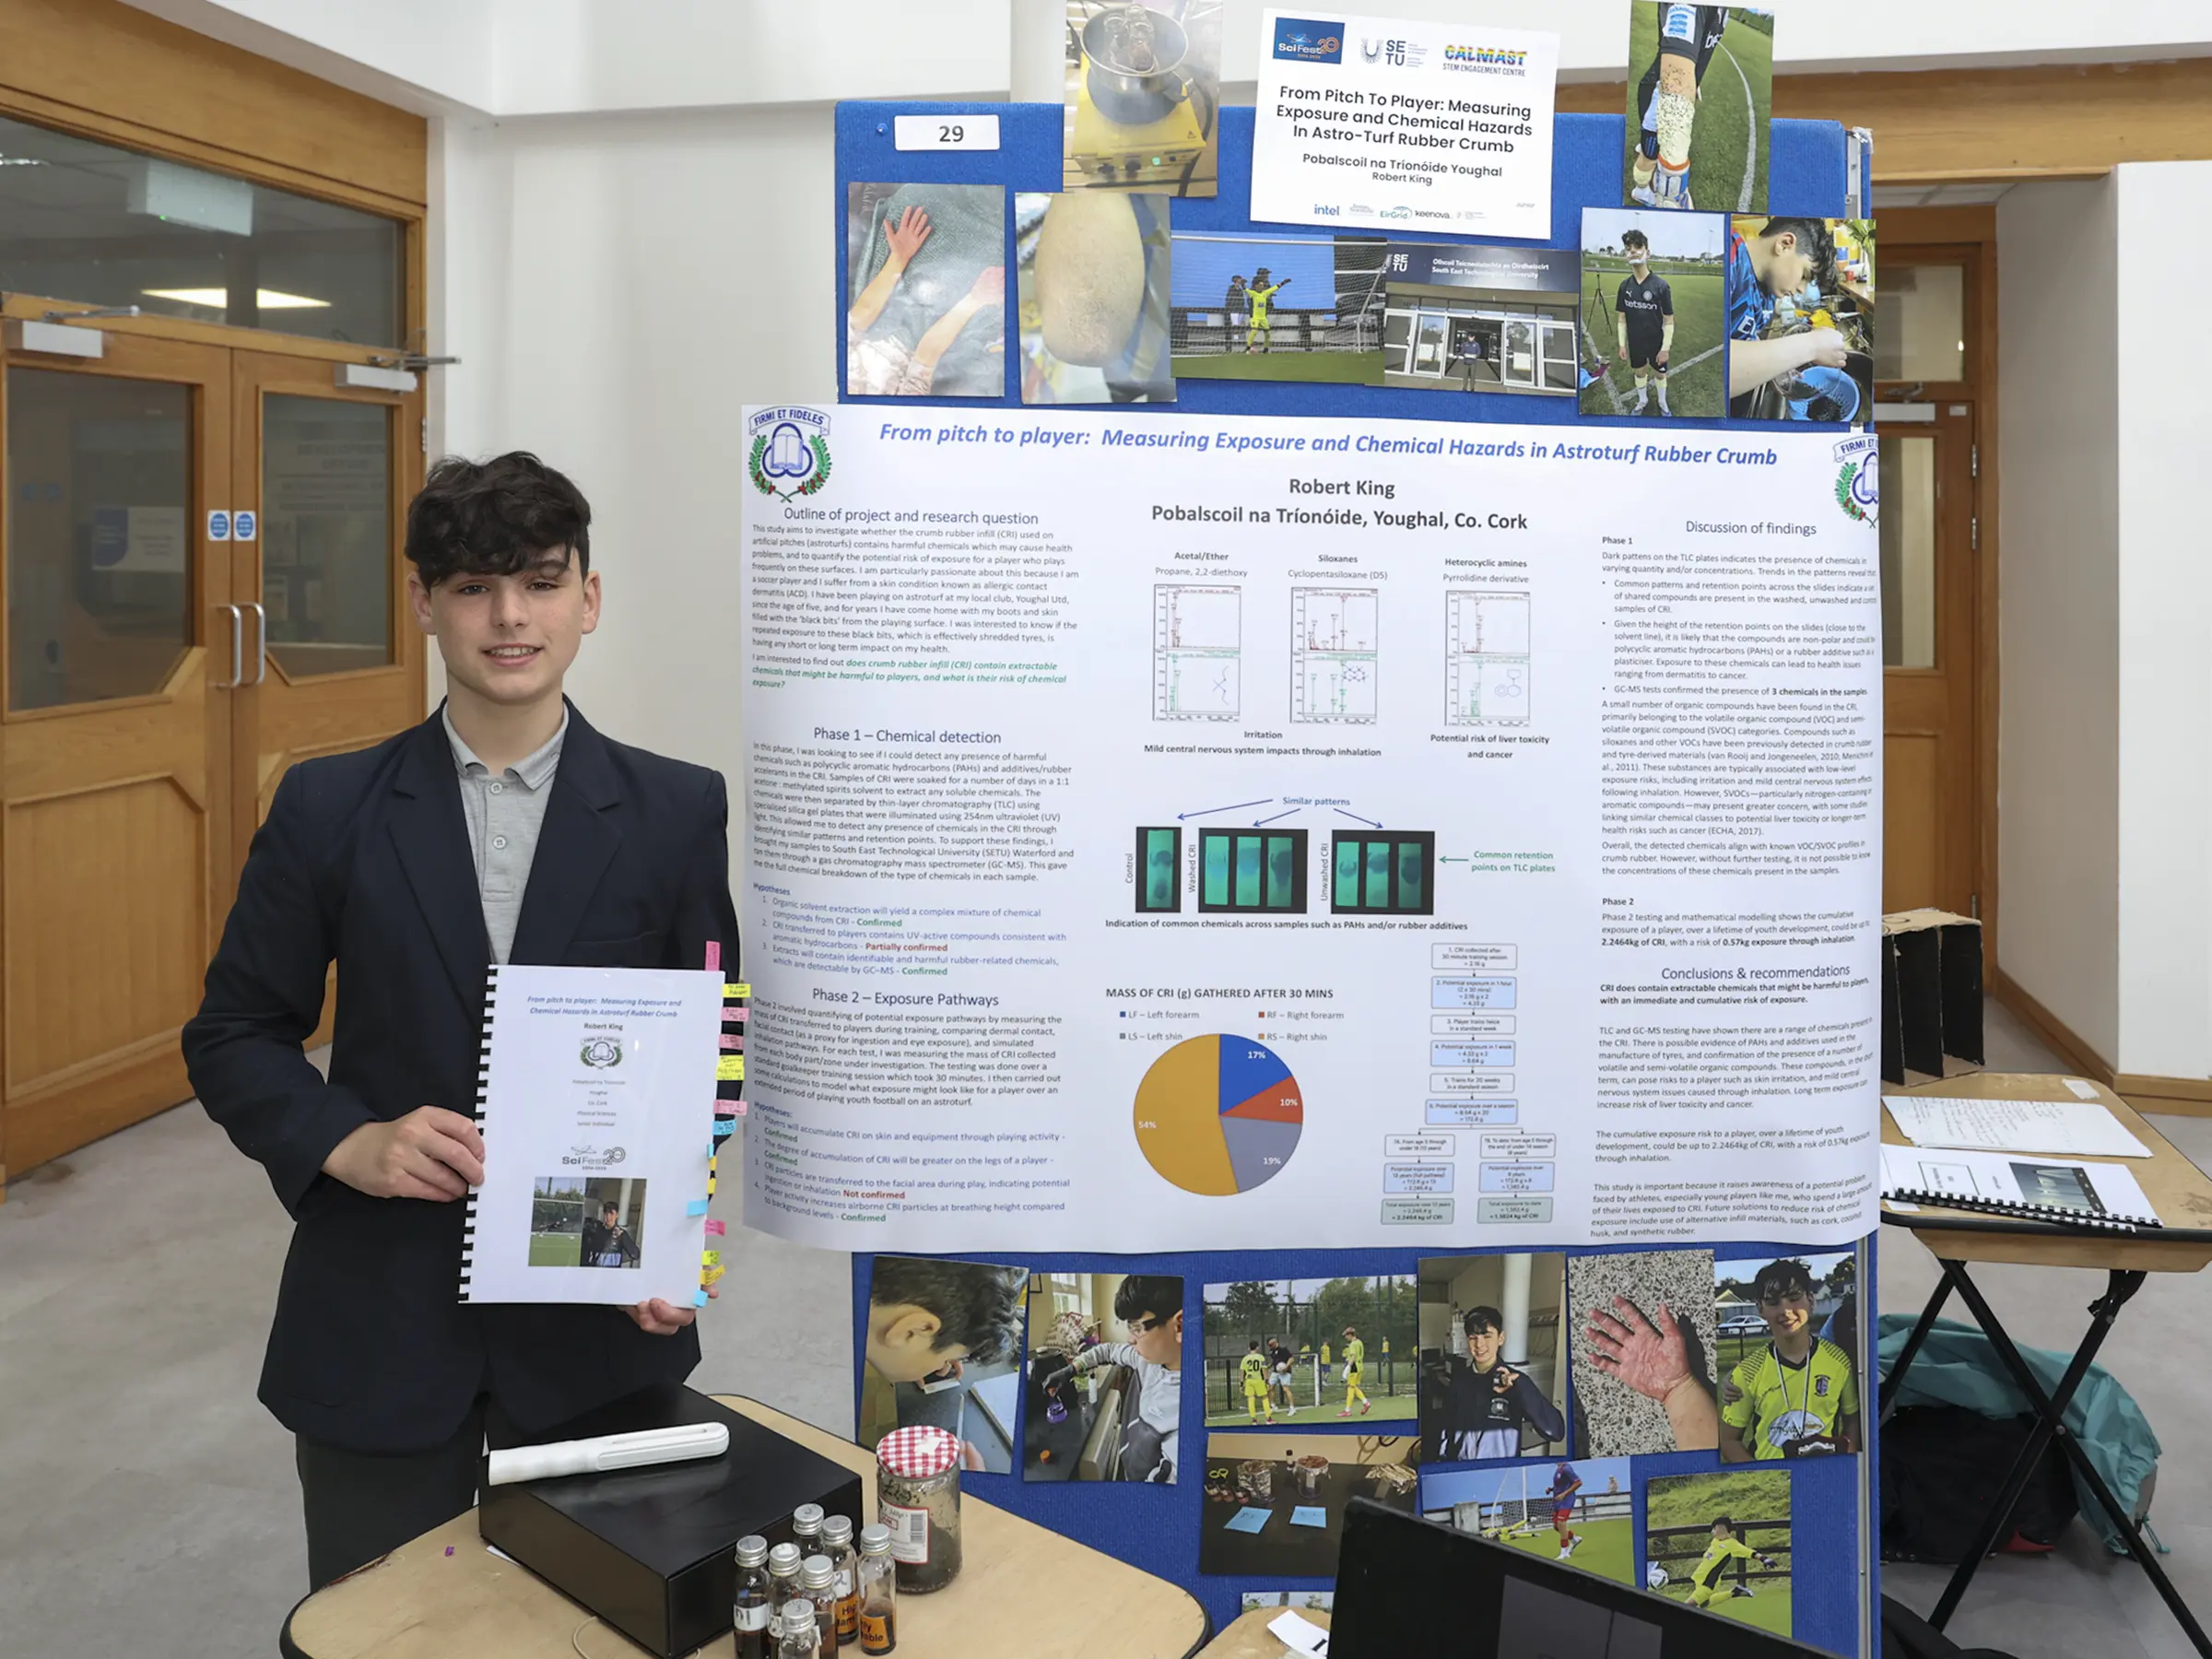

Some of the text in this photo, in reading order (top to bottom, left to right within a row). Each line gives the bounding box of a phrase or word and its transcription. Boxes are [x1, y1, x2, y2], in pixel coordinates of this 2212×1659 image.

[1386, 40, 1406, 53] SE
[1385, 53, 1405, 65] TU
[1444, 44, 1527, 65] CALMAST
[1461, 65, 1501, 75] ENGAGEMENT
[1502, 68, 1525, 76] CENTRE
[1280, 86, 1531, 121] From Pitch To Player: Measuring
[1277, 105, 1532, 135] Exposure and Chemical Hazards
[939, 125, 963, 142] 29
[1294, 125, 1513, 152] In Astro-Turf Rubber Crumb
[1303, 153, 1502, 178] Pobalscoil na Tríonóide Youghal
[1372, 171, 1432, 186] Robert King
[1314, 204, 1340, 216] intel
[1415, 209, 1451, 219] keenova
[1393, 253, 1408, 263] SE
[1393, 262, 1407, 272] TU
[754, 408, 824, 426] FIRMI ET FIDELES
[880, 424, 1777, 465] From pitch to player: Measuring Exposure and Chemical Hazards in Astroturf Rubber Crumb
[1841, 439, 1874, 453] FIRMI ET
[1290, 478, 1394, 500] Robert King
[784, 507, 1038, 526] Outline of project and research question
[1153, 505, 1527, 530] Pobalscoil na Tríonóide, Youghal, Co. Cork
[1687, 521, 1817, 537] Discussion of findings
[1174, 552, 1229, 560] Acetal/Ether
[1318, 555, 1358, 563] Siloxanes
[1445, 559, 1527, 568] Heterocyclic amines
[1156, 567, 1248, 578] Propane, 2,2-diethoxy
[1288, 570, 1388, 581] Cyclopentasiloxane (D5)
[1443, 573, 1488, 582] Pyrrolidine
[814, 727, 850, 740] Phase
[854, 729, 861, 741] 1
[877, 729, 935, 742] Chemical
[939, 730, 1001, 743] detection
[1244, 731, 1283, 739] Irritation
[1488, 735, 1497, 743] of
[1519, 735, 1549, 745] toxicity
[1266, 747, 1300, 756] impacts
[1302, 747, 1335, 757] through
[1338, 748, 1382, 757] inhalation
[1467, 750, 1484, 759] and
[1283, 796, 1350, 806] Similar patterns
[1474, 851, 1512, 859] Common
[1471, 864, 1498, 872] points
[1513, 864, 1528, 872] TLC
[1530, 864, 1556, 873] plates
[1150, 919, 1159, 927] of
[1201, 920, 1243, 928] chemicals
[1274, 921, 1309, 929] samples
[1368, 921, 1396, 930] and/or
[1430, 922, 1467, 930] additives
[865, 942, 901, 952] Partially
[1662, 965, 1850, 980] Conclusions & recommendations
[813, 988, 848, 1003] Phase
[852, 992, 859, 1003] 2
[875, 992, 934, 1006] Exposure
[938, 994, 999, 1008] Pathways
[1106, 988, 1333, 1000] MASS OF CRI (g) GATHERED AFTER 30 MINS
[1247, 1051, 1266, 1060] 17%
[1280, 1098, 1298, 1107] 10%
[1138, 1121, 1157, 1130] 54%
[1263, 1157, 1281, 1166] 19%
[843, 1190, 905, 1199] Not confirmed
[1247, 1359, 1259, 1371] 20
